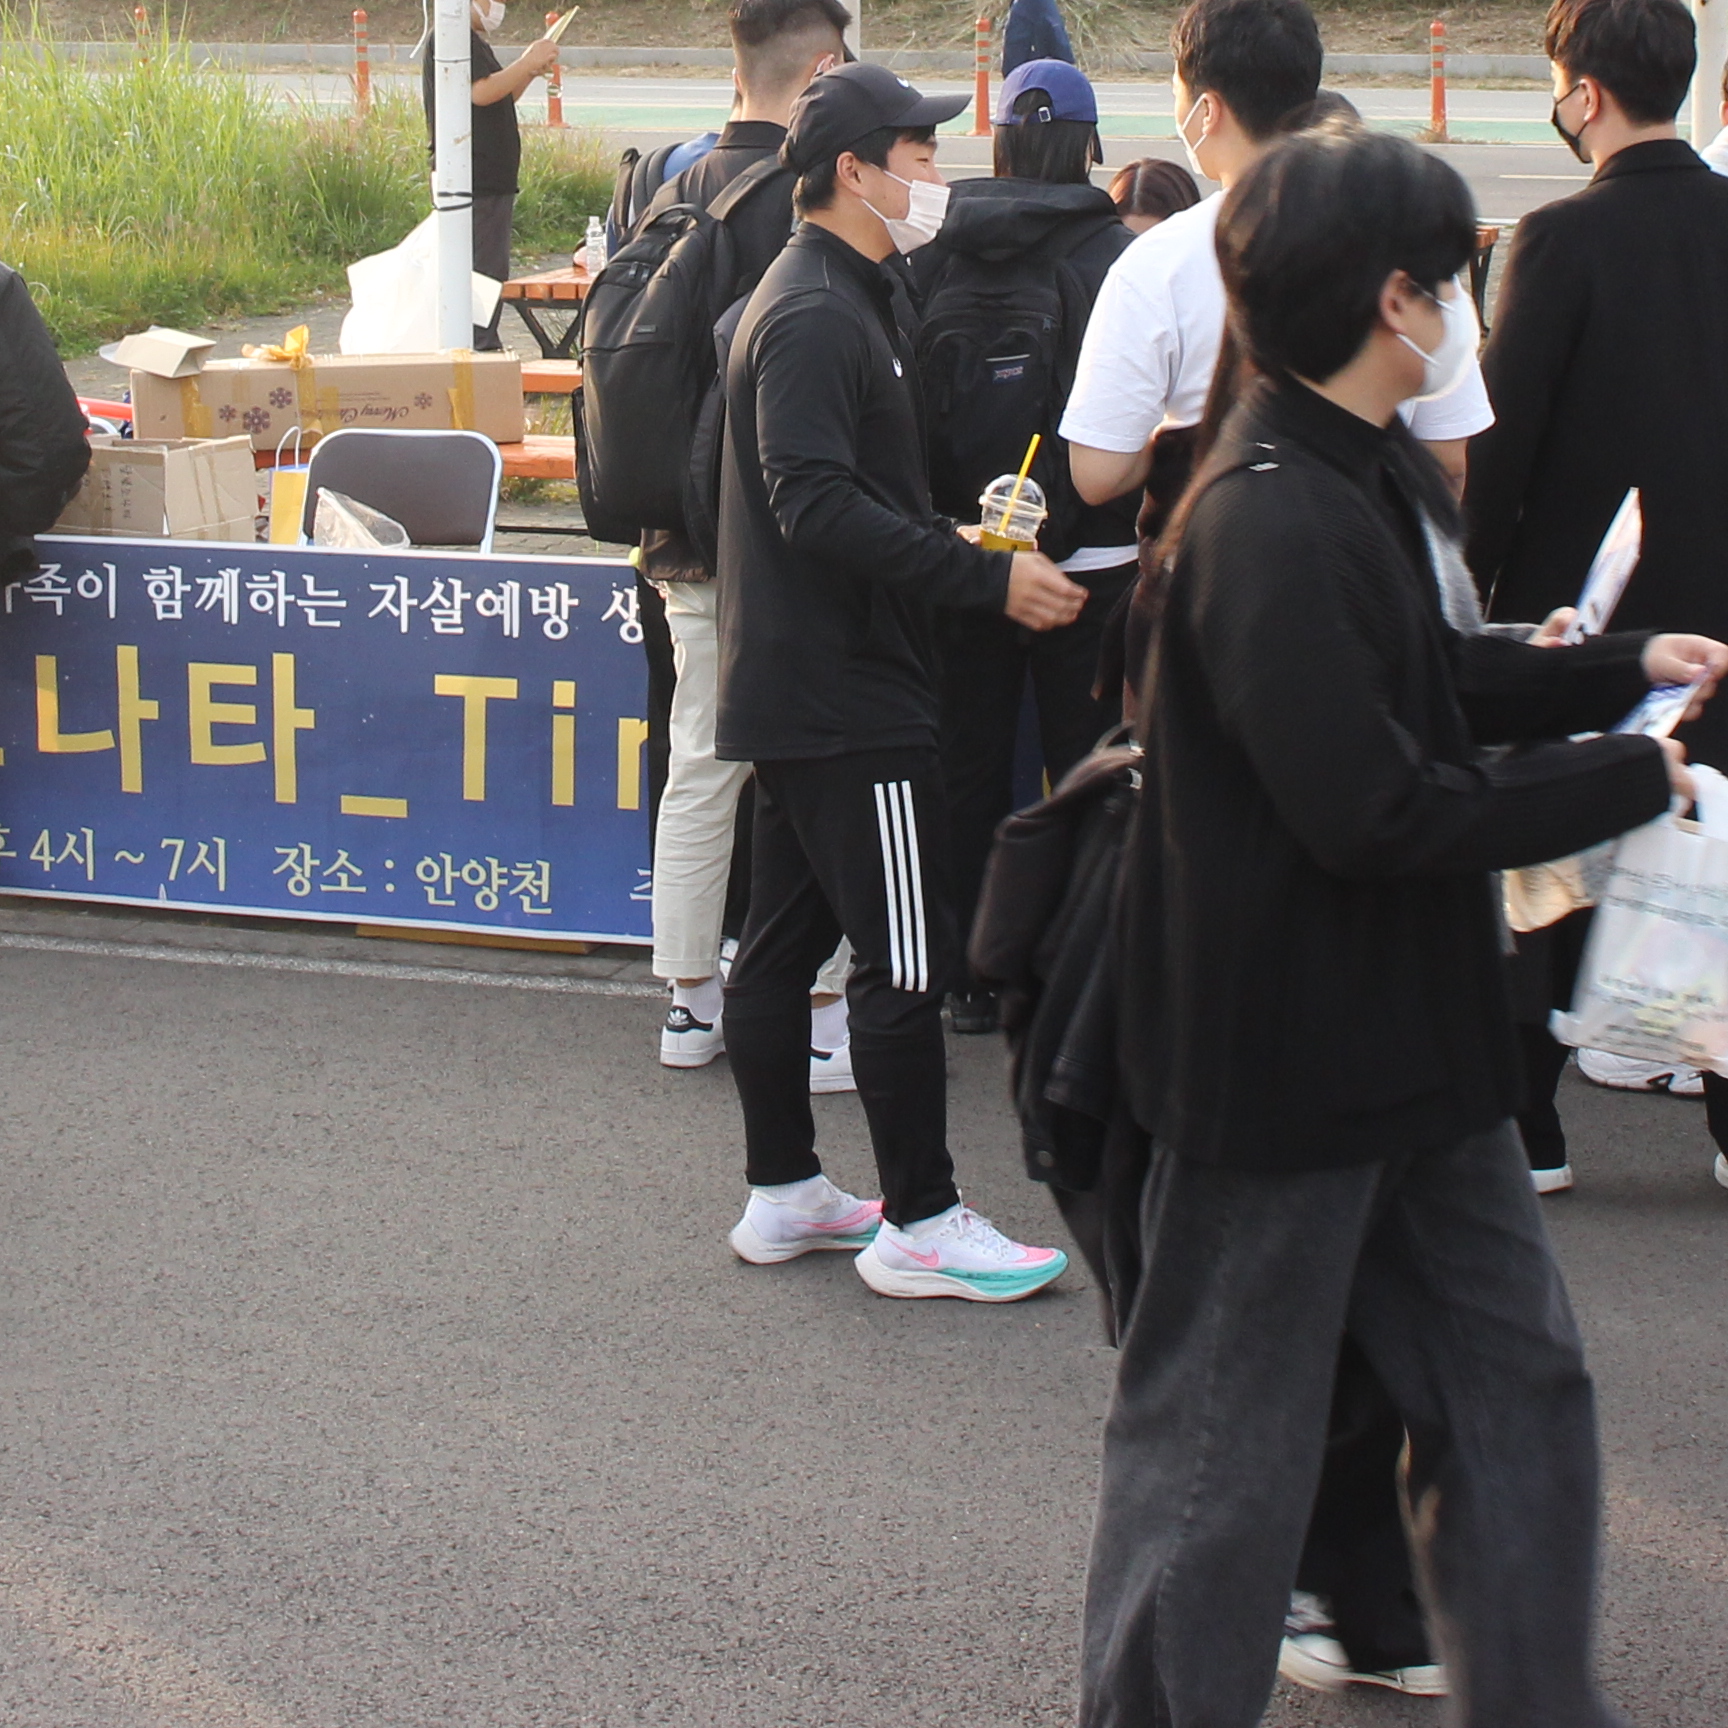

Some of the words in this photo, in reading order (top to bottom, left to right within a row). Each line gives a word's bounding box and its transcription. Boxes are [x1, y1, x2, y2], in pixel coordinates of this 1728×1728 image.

[142, 566, 348, 630] 함께하는
[368, 574, 579, 639] 자살예방
[29, 827, 97, 885] 4시
[161, 835, 229, 893] 7시
[272, 844, 369, 896] 장소
[414, 852, 556, 916] 안양천
